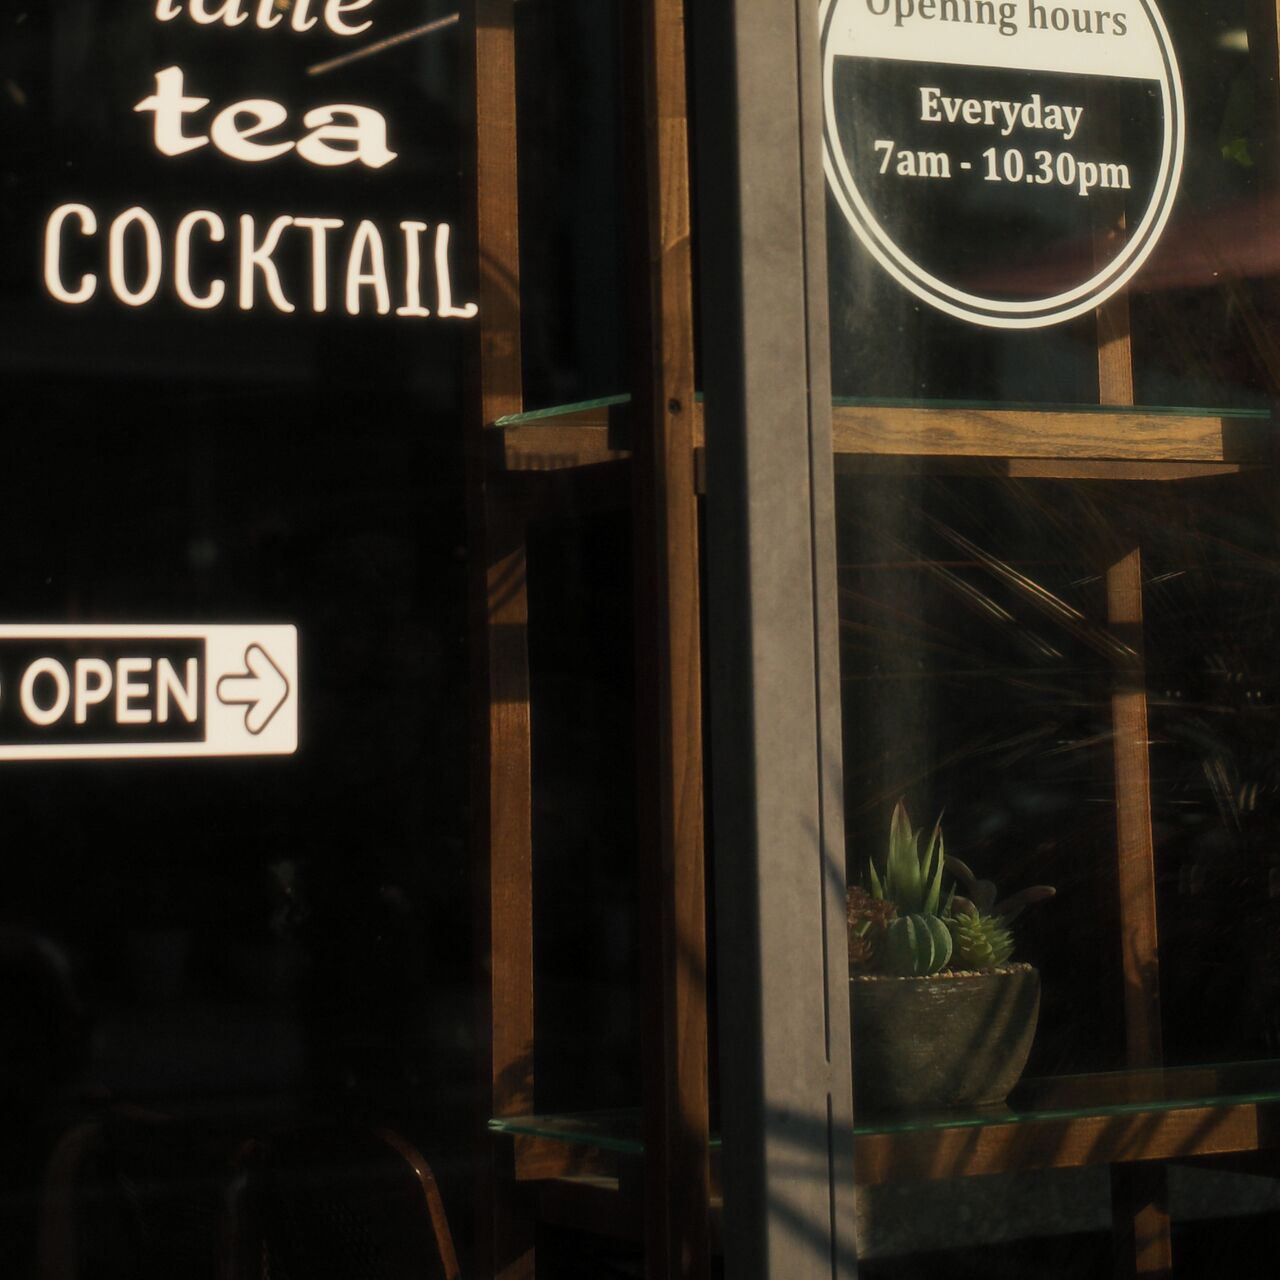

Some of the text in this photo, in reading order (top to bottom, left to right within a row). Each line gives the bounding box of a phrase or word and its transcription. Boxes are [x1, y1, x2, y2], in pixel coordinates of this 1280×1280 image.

[133, 65, 398, 169] tea
[918, 87, 1083, 141] Everyday
[873, 140, 951, 178] 7am
[982, 147, 1131, 197] 10.30pm
[44, 203, 479, 319] COCKTAIL
[19, 657, 199, 726] OPEN
